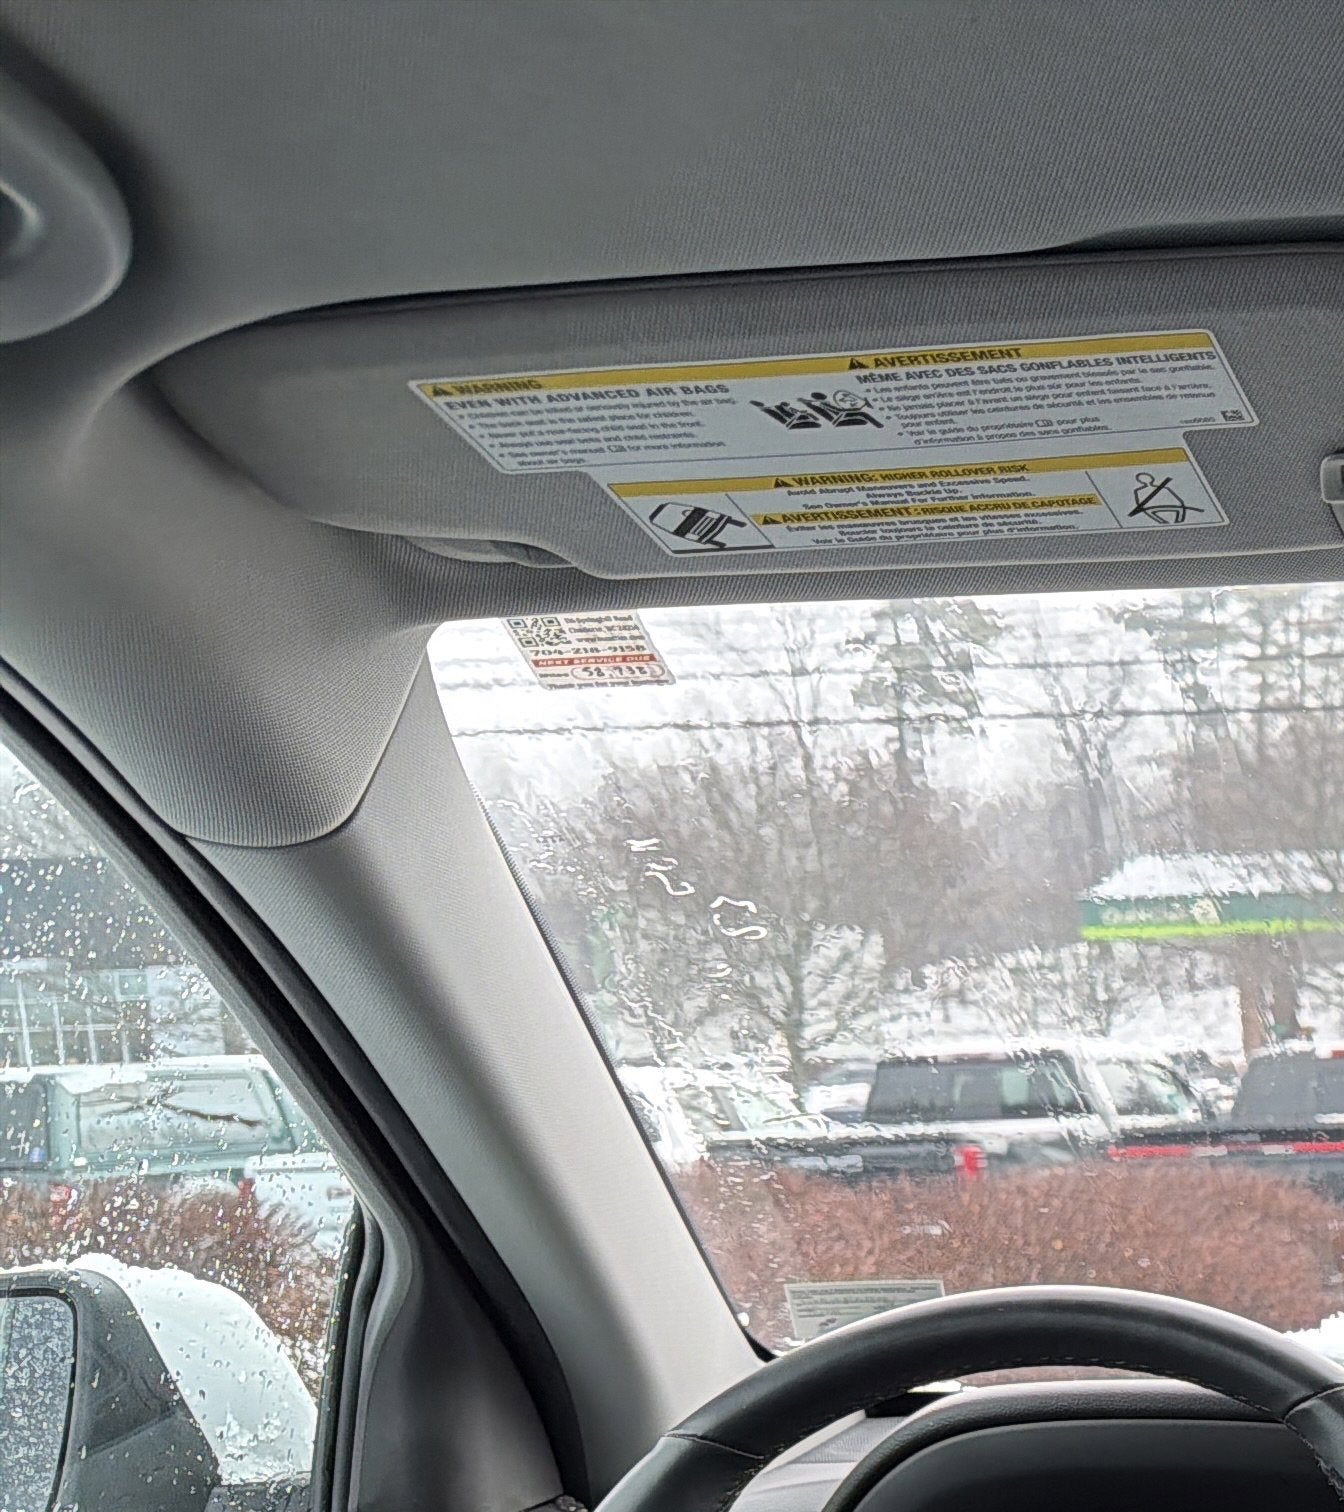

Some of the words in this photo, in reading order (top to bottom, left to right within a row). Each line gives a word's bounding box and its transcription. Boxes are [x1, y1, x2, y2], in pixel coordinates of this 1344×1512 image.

[855, 371, 902, 384] MÊME
[905, 368, 943, 381] AVEC
[945, 366, 975, 378] DES
[977, 363, 1018, 374] SACS
[1020, 357, 1114, 372] GONFLABLES
[1115, 351, 1217, 366] INTELLIGENTS
[873, 347, 1022, 369] AVERTISSEMENT
[443, 399, 492, 410] EVEN
[492, 395, 542, 407] WITH
[546, 389, 640, 402] ADVANCED
[645, 386, 677, 397] AIR
[679, 384, 730, 396] BAGS
[451, 379, 542, 395] WARNING
[880, 470, 928, 481] HIGHER
[930, 466, 995, 478] ROLLOVER
[998, 464, 1030, 474] RISK
[781, 507, 913, 524] AVERTISSEMENT
[923, 503, 968, 515] RISQUE
[969, 501, 1010, 512] ACCRU
[1012, 500, 1030, 510] DE
[1030, 496, 1097, 509] CAPOTAGE
[573, 657, 623, 665] SERVICE
